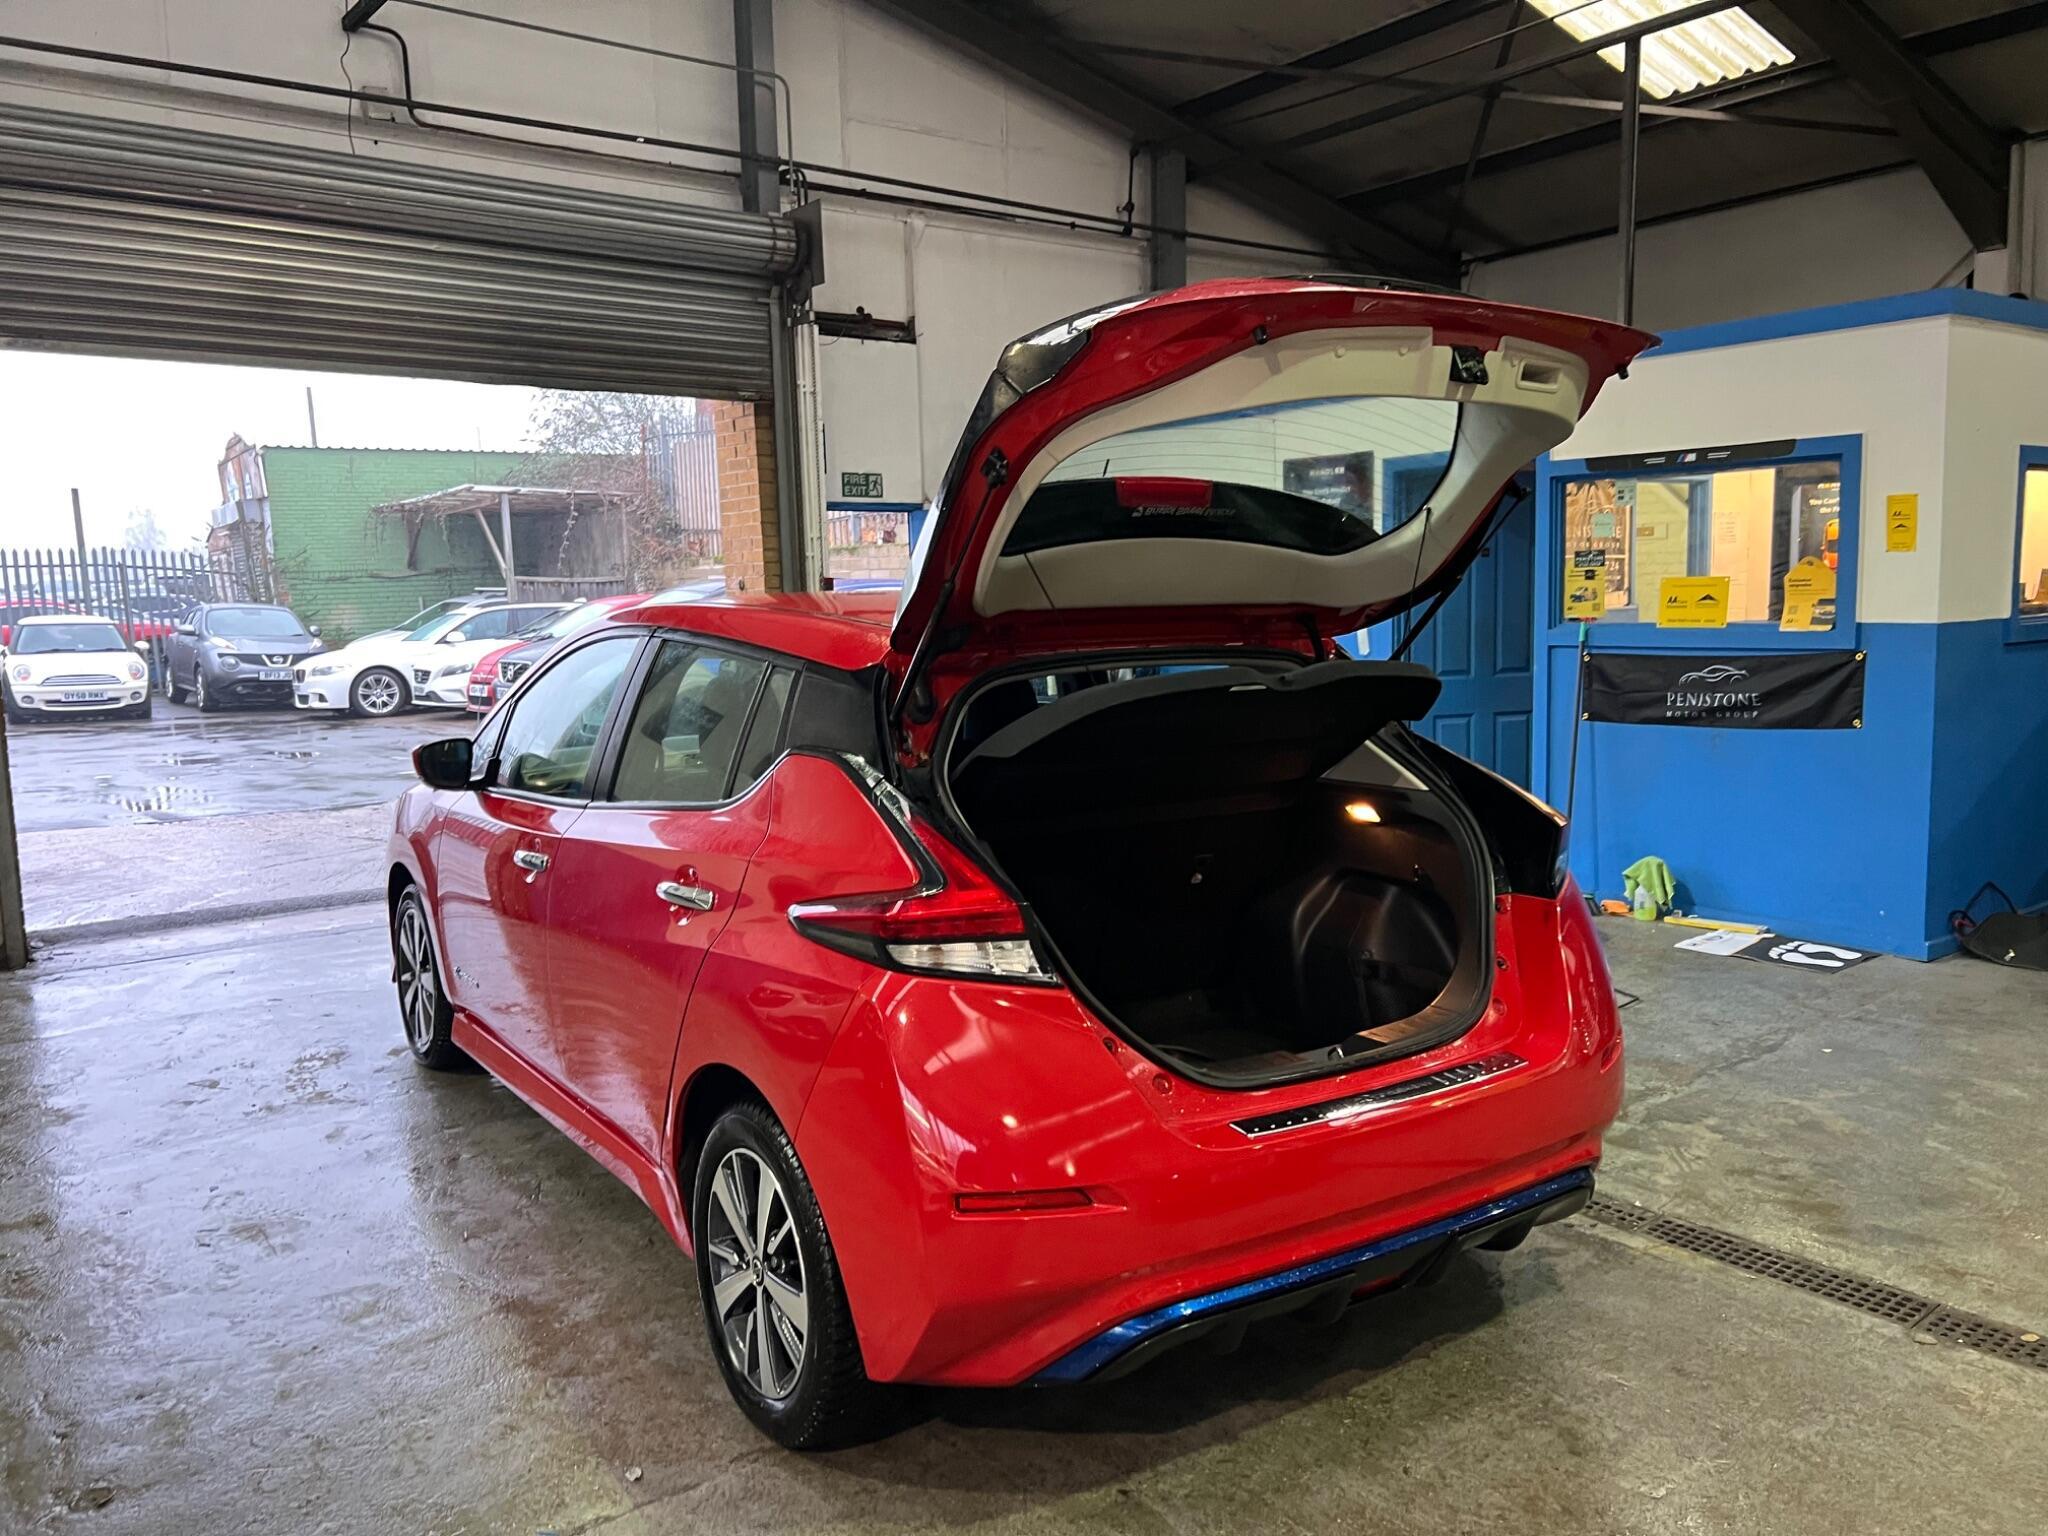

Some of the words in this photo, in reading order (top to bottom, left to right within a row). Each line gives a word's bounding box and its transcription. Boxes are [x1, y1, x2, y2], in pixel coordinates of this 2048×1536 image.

[843, 474, 866, 485] FIRE
[844, 485, 867, 496] EXIT
[1666, 691, 1762, 707] PENISTONE
[1665, 710, 1706, 718] MOTOR
[1716, 710, 1759, 718] GROUP
